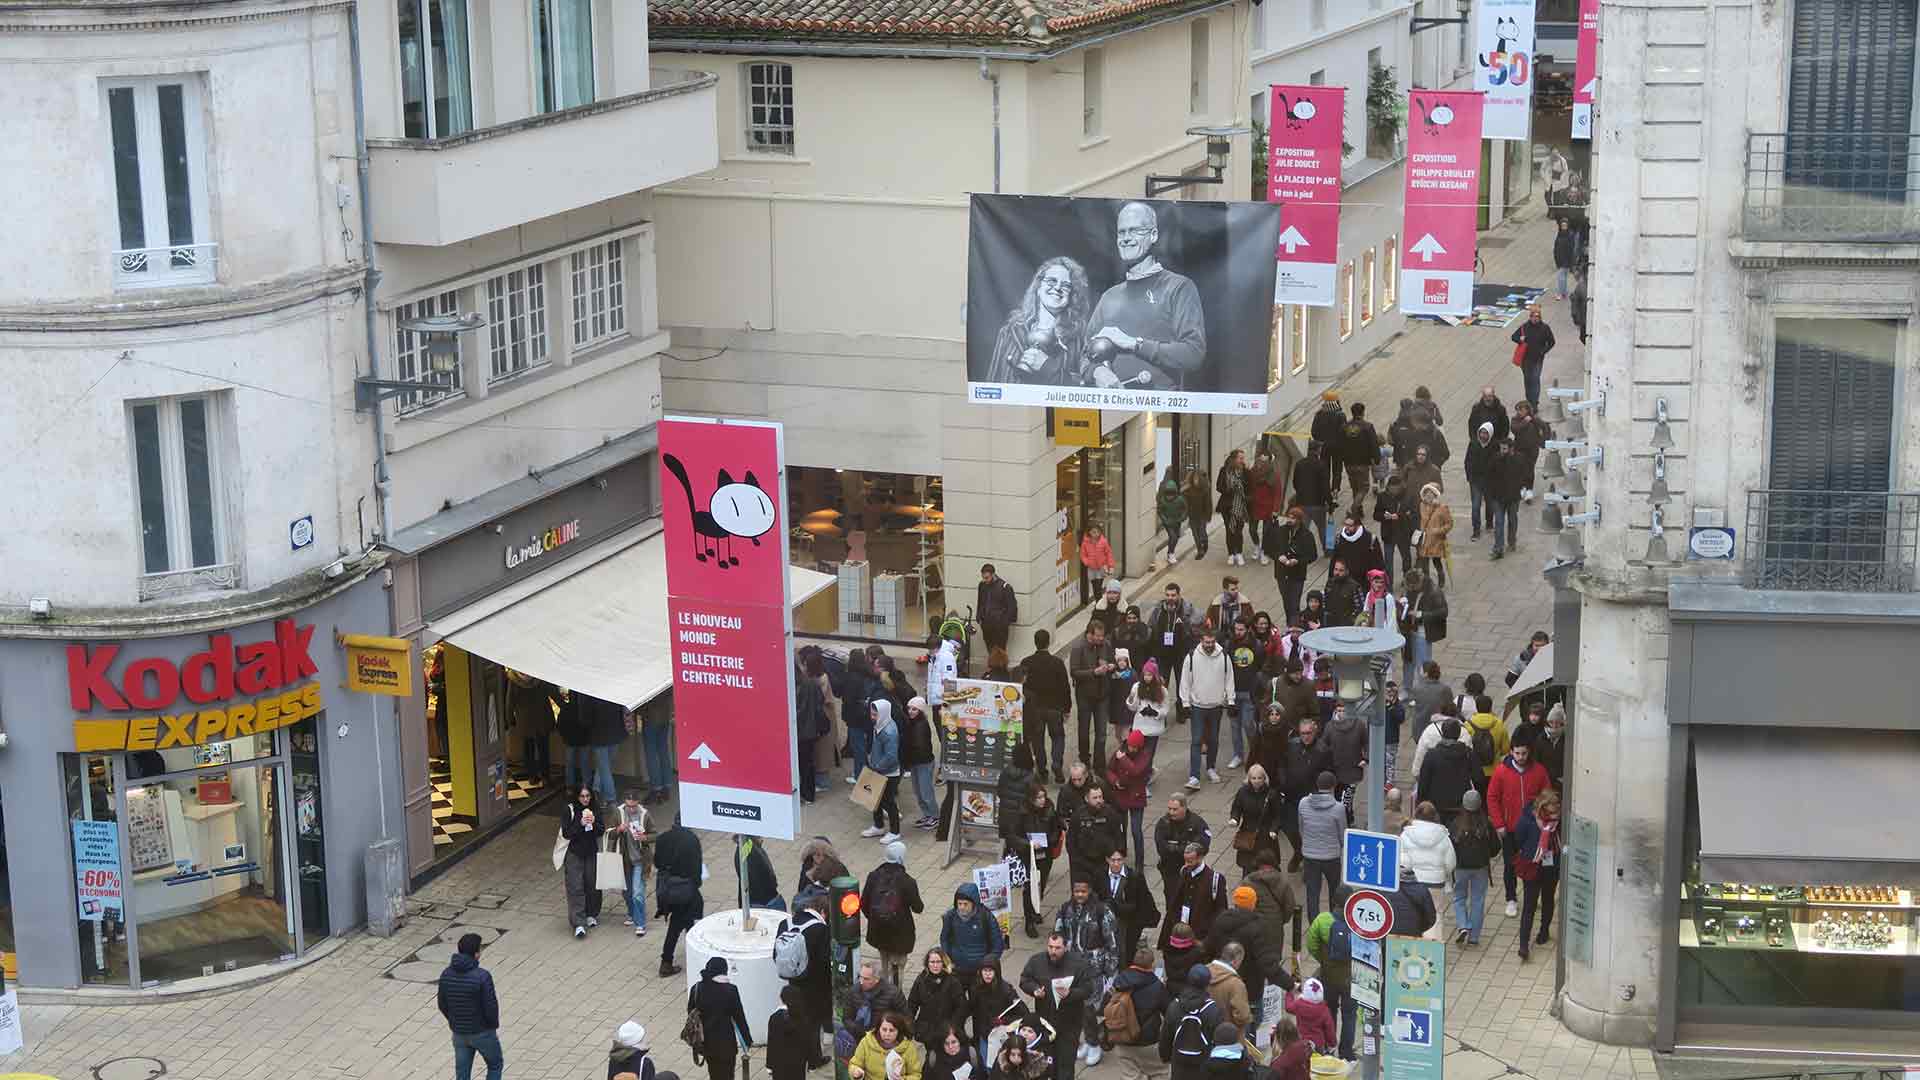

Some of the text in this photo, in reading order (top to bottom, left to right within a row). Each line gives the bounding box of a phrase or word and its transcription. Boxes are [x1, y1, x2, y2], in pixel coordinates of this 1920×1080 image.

[1488, 51, 1529, 86] 50
[1275, 148, 1314, 157] EXPOSITION
[1276, 159, 1320, 168] JULIE DOUCET
[1274, 175, 1283, 183] LA
[1284, 176, 1305, 184] PLACE
[1306, 176, 1315, 184] DU
[1323, 177, 1336, 185] ART
[1412, 168, 1443, 177] PHILIPPE
[1299, 190, 1313, 200] pied
[1045, 391, 1066, 402] Julie
[1068, 392, 1101, 404] DOUCET
[1103, 394, 1110, 404] &
[1111, 394, 1134, 406] Chris
[1135, 396, 1161, 407] WARE
[1168, 397, 1189, 408] 2022
[520, 536, 544, 563] mie
[678, 611, 743, 630] LE NOUVEAU
[680, 630, 717, 646] MONDE
[66, 618, 319, 711] Kodak
[357, 655, 391, 668] Kodak
[681, 651, 745, 670] BILLETTERIE
[358, 665, 398, 679] Express
[682, 670, 754, 690] CENTRE-VILLE
[126, 680, 322, 750] EXPRESS
[79, 870, 121, 889] -60%
[1357, 907, 1381, 923] 7,5t
